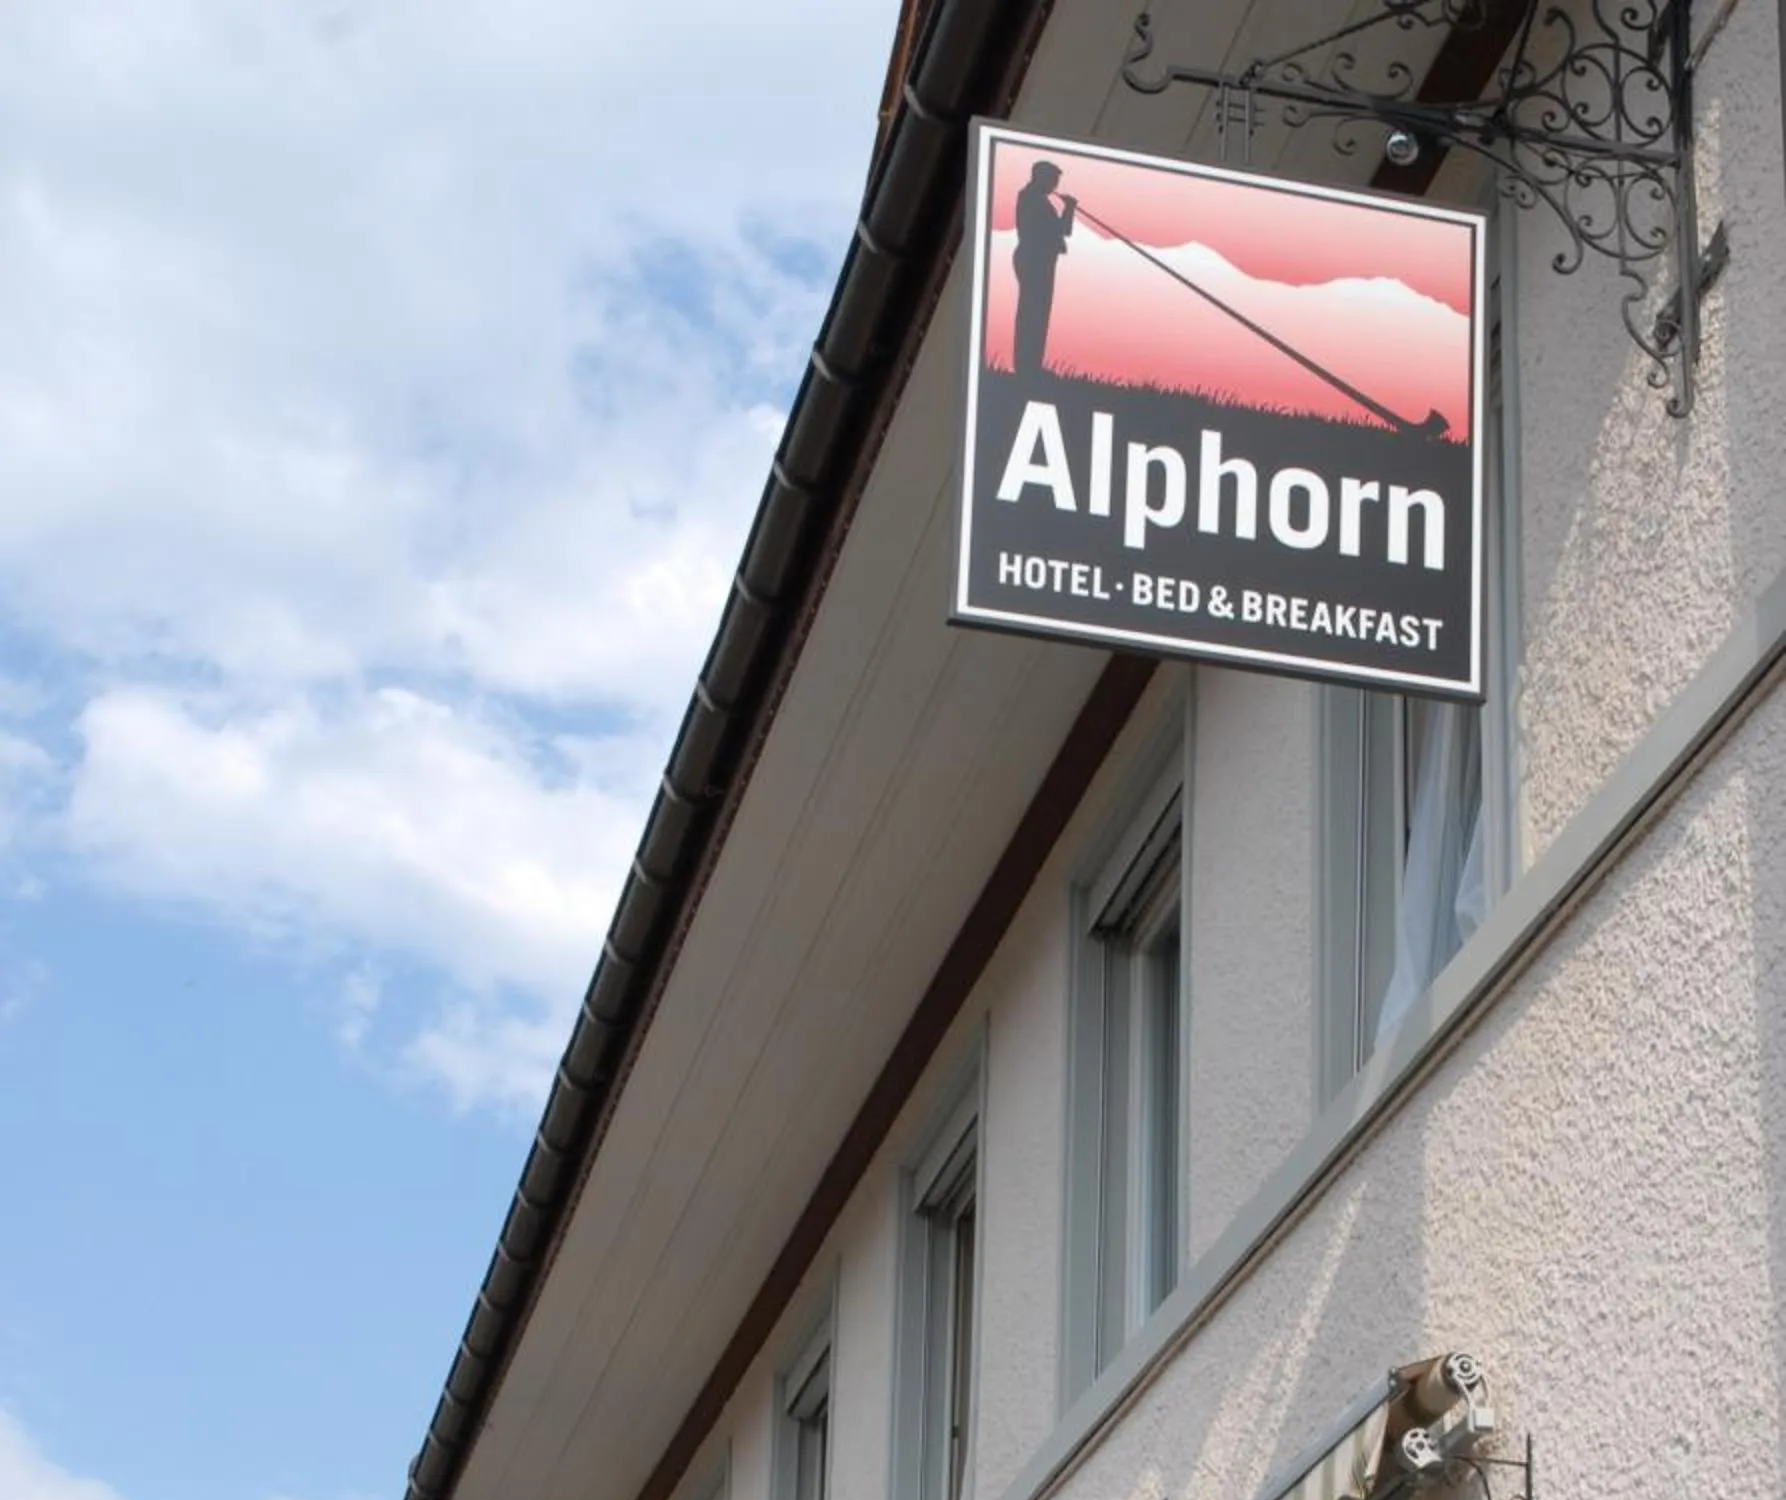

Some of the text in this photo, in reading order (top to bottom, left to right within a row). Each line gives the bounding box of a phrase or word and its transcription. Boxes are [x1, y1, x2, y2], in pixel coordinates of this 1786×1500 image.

[996, 400, 1445, 571] Alphorn
[998, 551, 1443, 651] HOTEL BED & BREAKFAST
